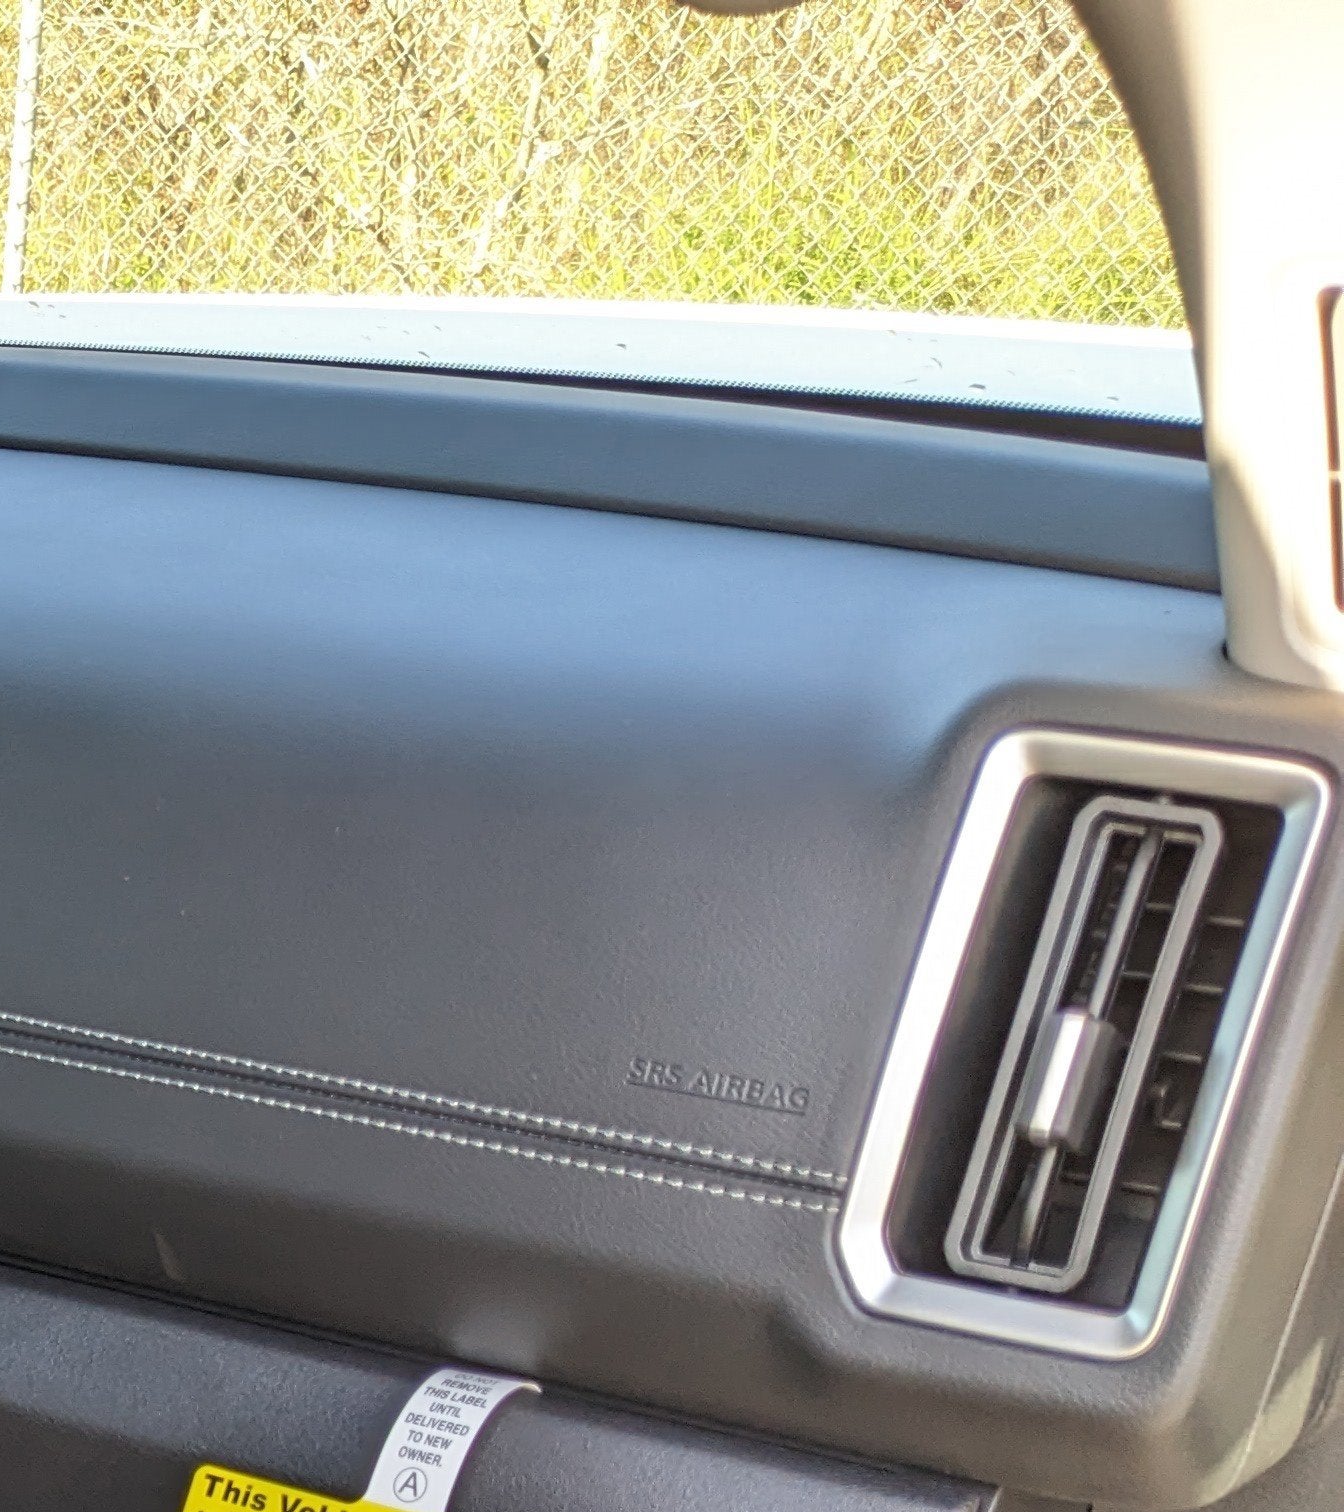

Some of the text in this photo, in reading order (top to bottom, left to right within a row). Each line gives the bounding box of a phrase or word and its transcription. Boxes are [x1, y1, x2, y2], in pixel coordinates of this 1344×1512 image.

[625, 1055, 810, 1110] SRS AIRBAG
[424, 1387, 487, 1408] THIS LABEL
[441, 1379, 492, 1395] REMOVE
[429, 1402, 462, 1418] UNTIL
[404, 1413, 469, 1436] DELIVERED
[406, 1430, 452, 1450] TO NEW
[398, 1446, 442, 1466] OWNER.
[204, 1474, 267, 1512] This
[398, 1472, 417, 1497] A
